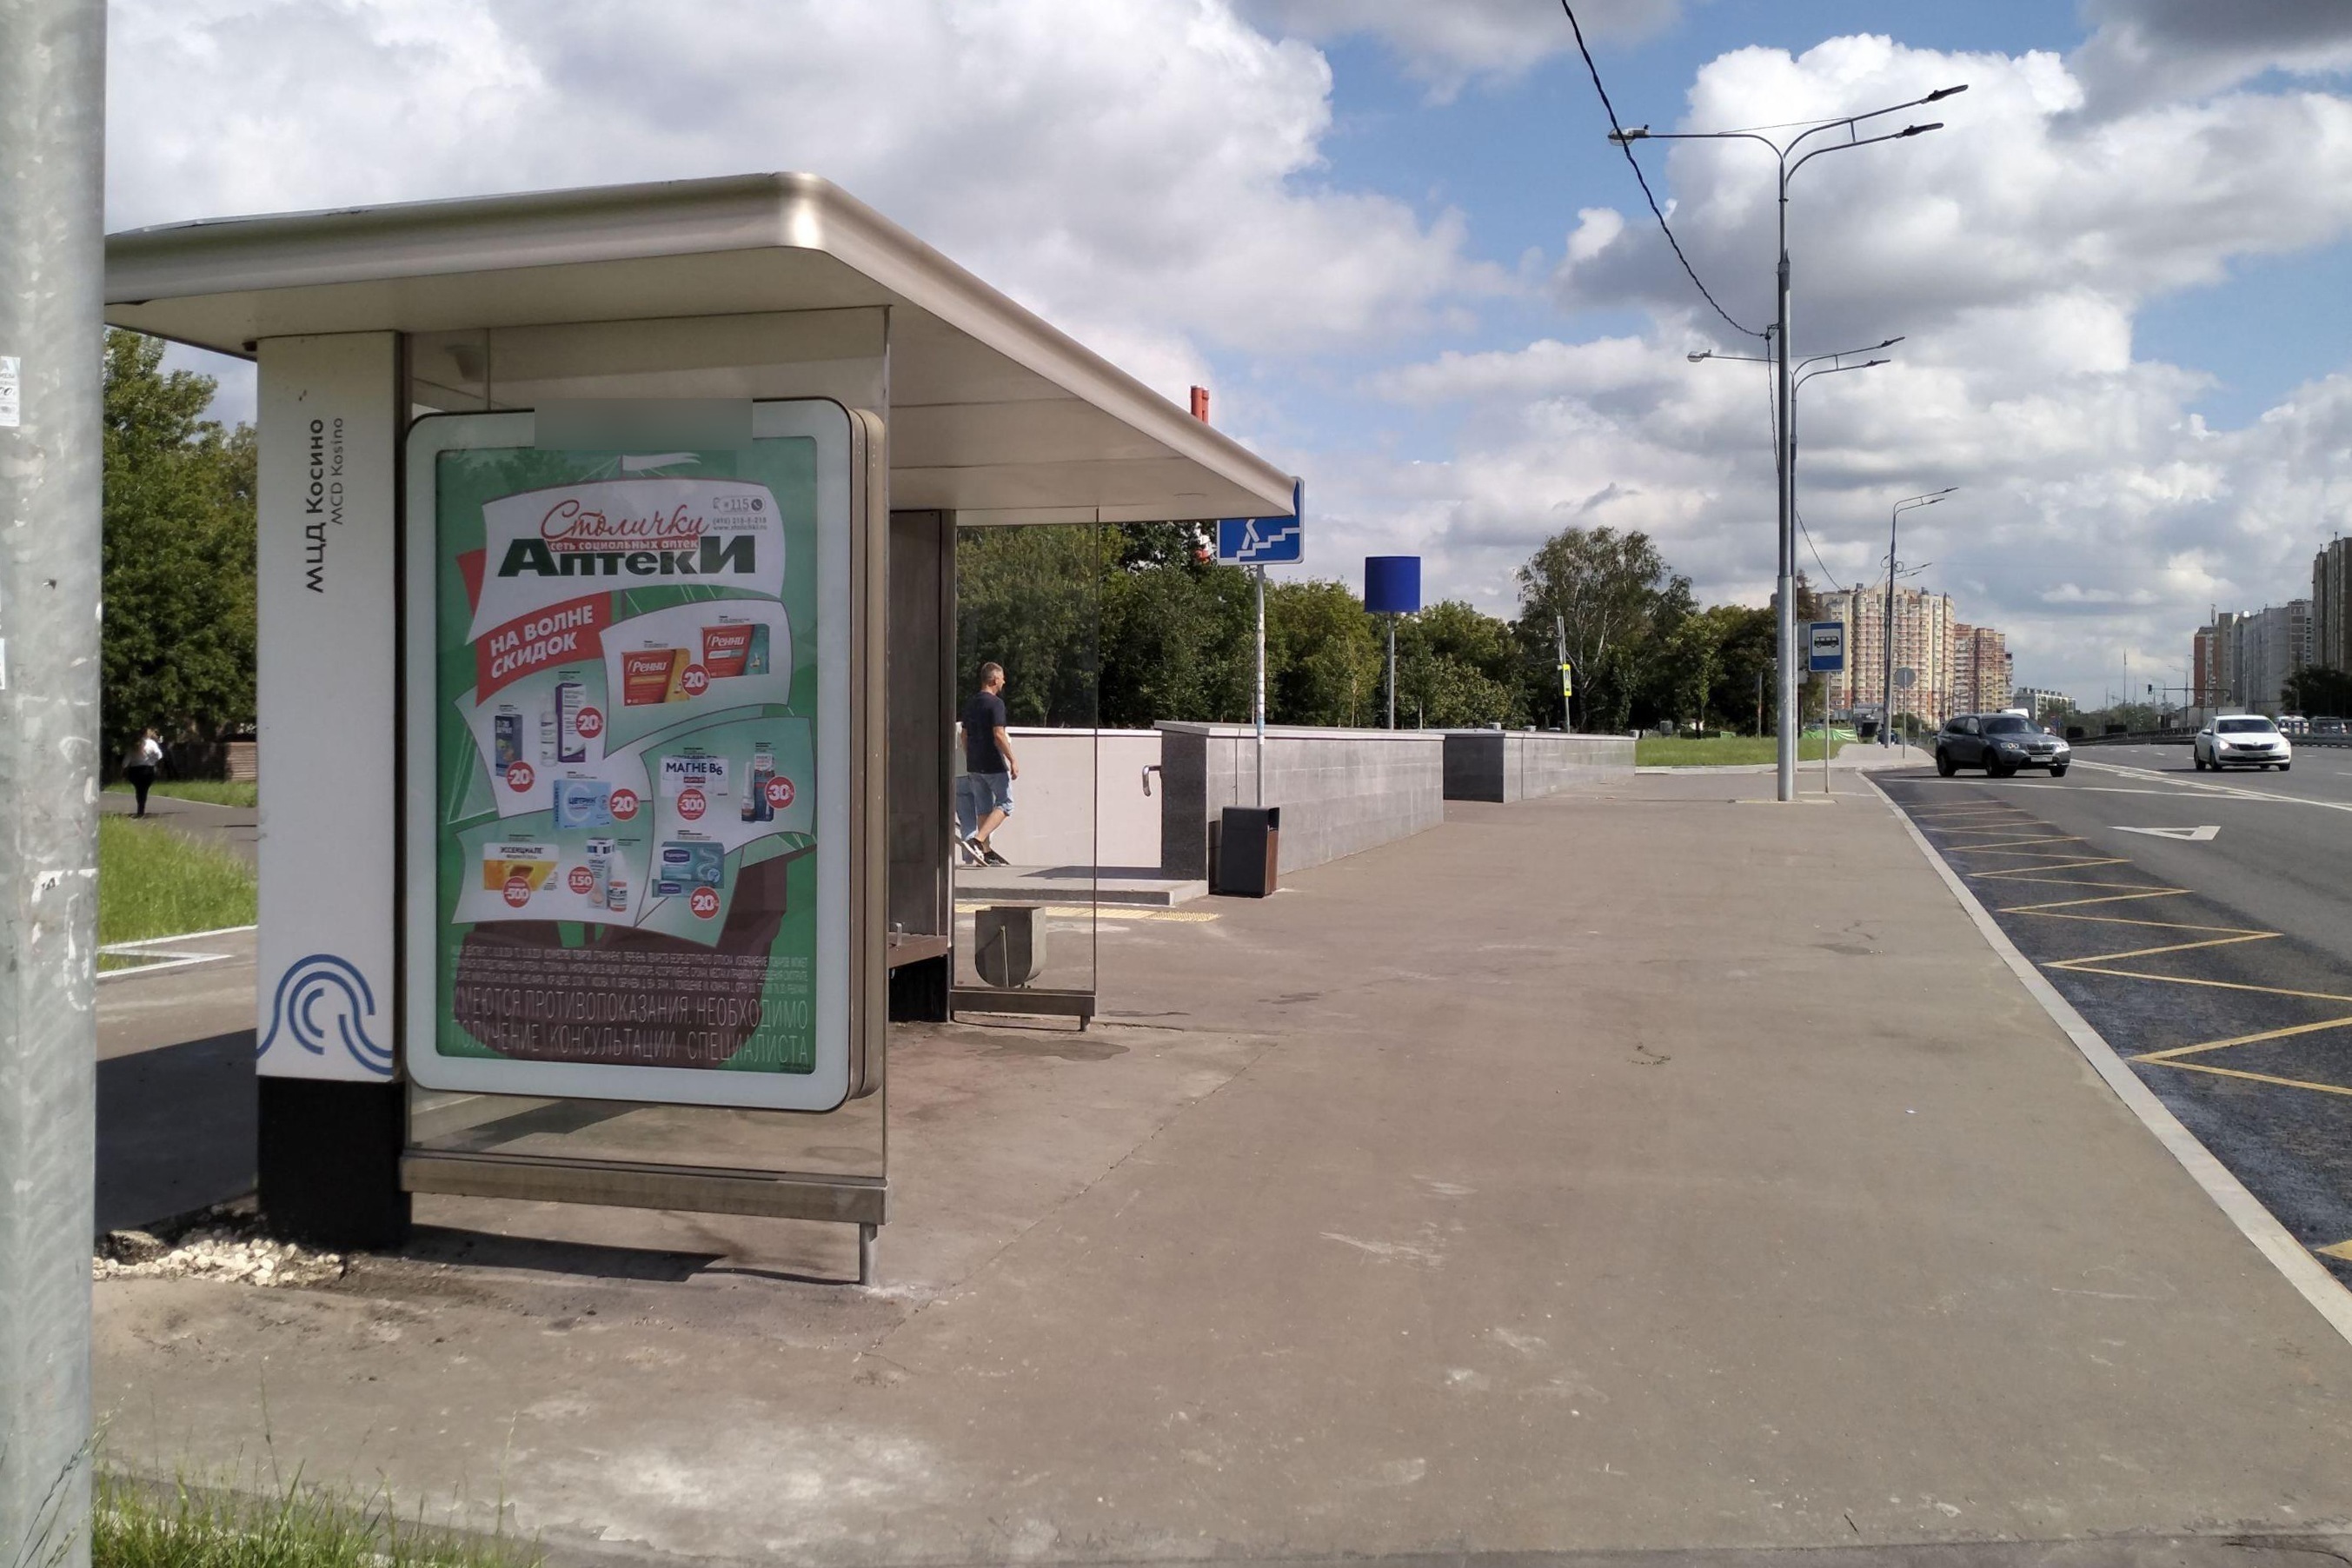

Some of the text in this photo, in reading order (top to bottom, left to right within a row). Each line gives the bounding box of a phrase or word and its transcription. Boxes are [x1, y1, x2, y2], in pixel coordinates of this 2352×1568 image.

[330, 417, 343, 525] MCD Kosino
[306, 419, 327, 594] МЦД Косино
[541, 499, 710, 540] Столички
[550, 539, 699, 551] сеть социальных аптек
[490, 605, 594, 657] НА ВОЛНЕ
[491, 632, 577, 679] СКИДОК
[666, 762, 708, 773] МАГНЕ
[454, 986, 521, 1017] ИМЕЮТСЯ
[696, 997, 808, 1030] НЕОБХОДИМО
[452, 1019, 809, 1063] ПОЛУЧЕНИЕ КОНСУЛЬТАЦИИ СПЕЦИАЛИСТА
